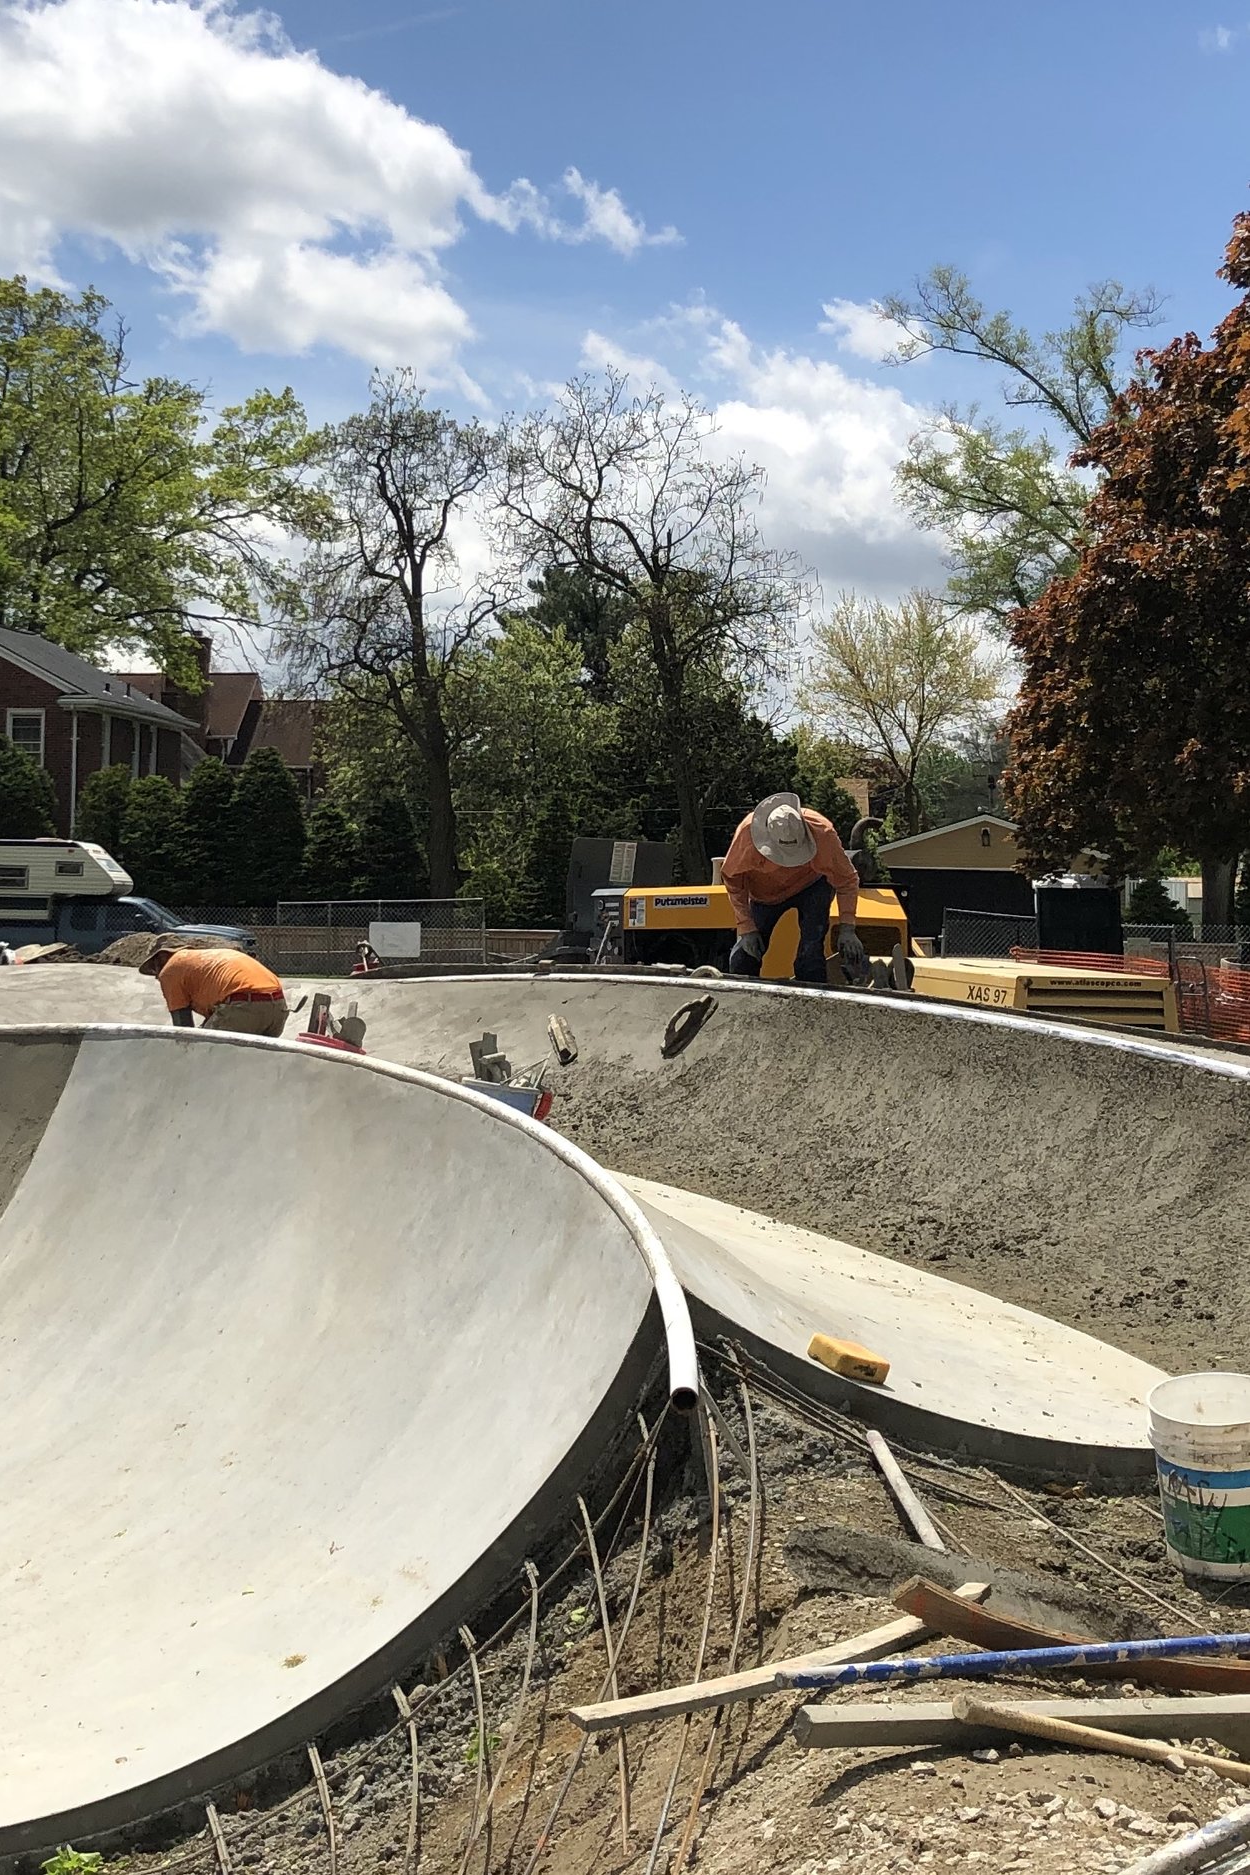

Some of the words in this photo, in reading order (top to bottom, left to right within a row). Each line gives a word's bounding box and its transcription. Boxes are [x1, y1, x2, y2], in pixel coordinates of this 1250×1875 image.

[654, 896, 708, 907] Putzmeister
[1049, 978, 1142, 988] www.atlascopco.com
[966, 985, 990, 1002] XAS
[993, 989, 1007, 1005] 97
